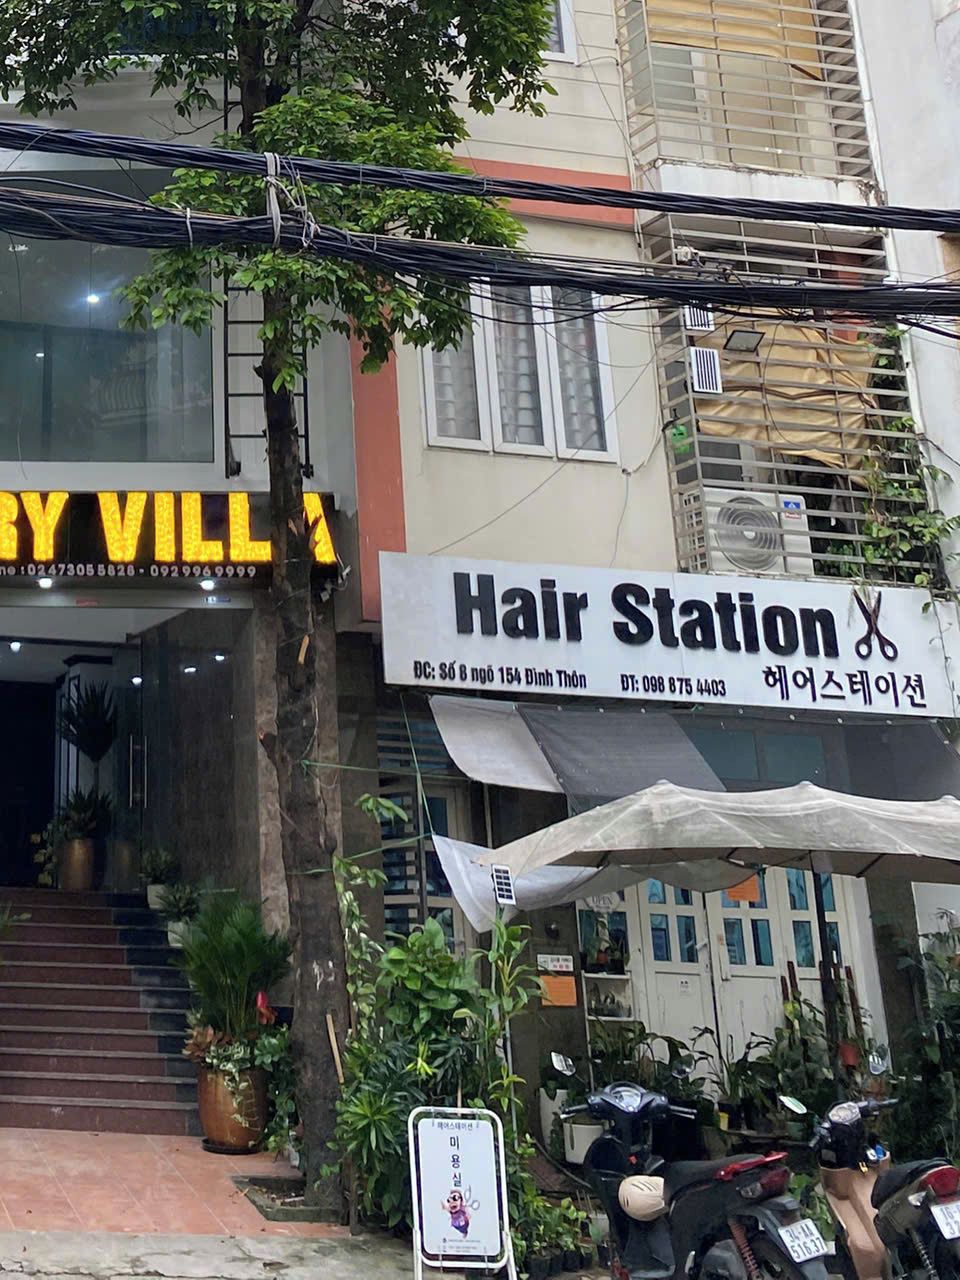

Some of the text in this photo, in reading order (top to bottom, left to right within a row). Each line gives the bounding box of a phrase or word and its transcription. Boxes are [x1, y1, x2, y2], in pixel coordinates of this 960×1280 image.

[453, 572, 841, 658] Hair Station
[413, 660, 587, 689] ĐC: Số 8 ngõ 154 Đình Thôn
[620, 673, 727, 697] ĐT: 098 875 4403
[762, 665, 927, 708] 헤어스테이션
[940, 1204, 960, 1220] 16-
